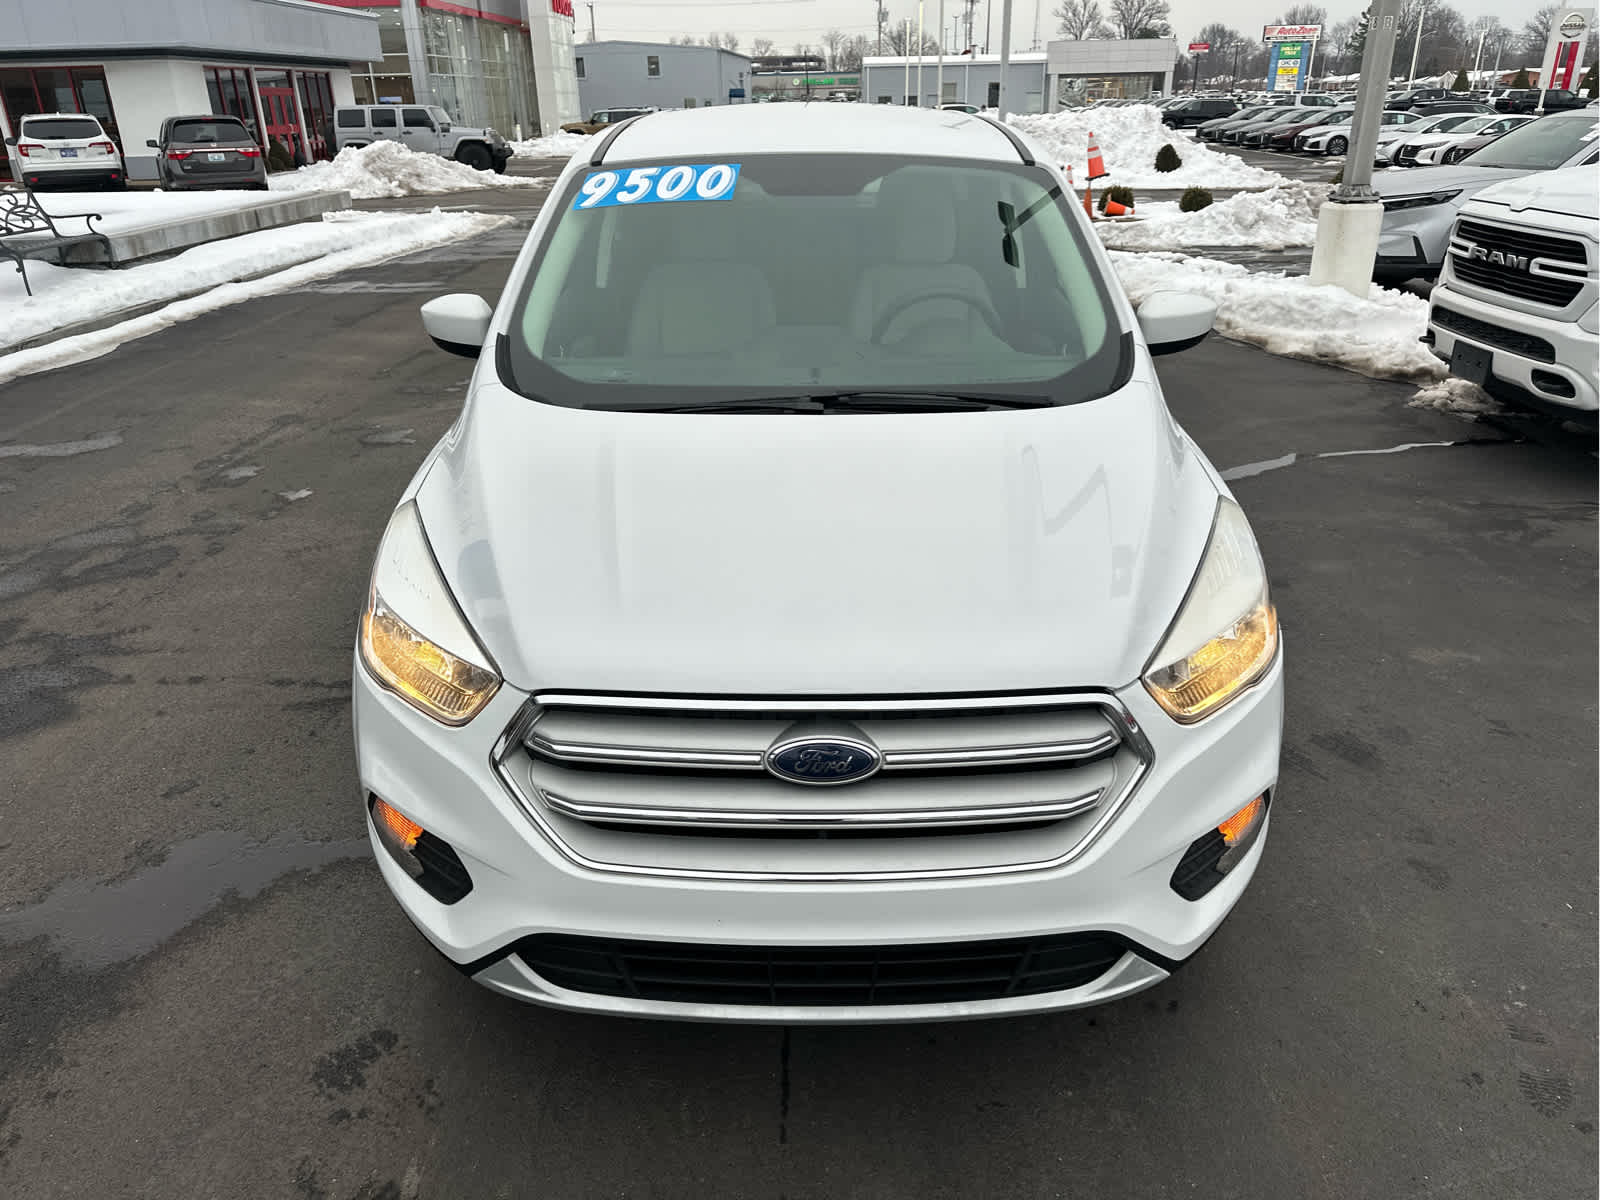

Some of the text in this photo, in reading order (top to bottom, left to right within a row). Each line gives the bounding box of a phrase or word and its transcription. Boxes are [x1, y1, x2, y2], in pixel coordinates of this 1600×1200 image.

[1277, 25, 1318, 36] AutoZone
[579, 164, 736, 209] 9500
[1471, 245, 1529, 271] RAM
[794, 749, 853, 774] Ford
